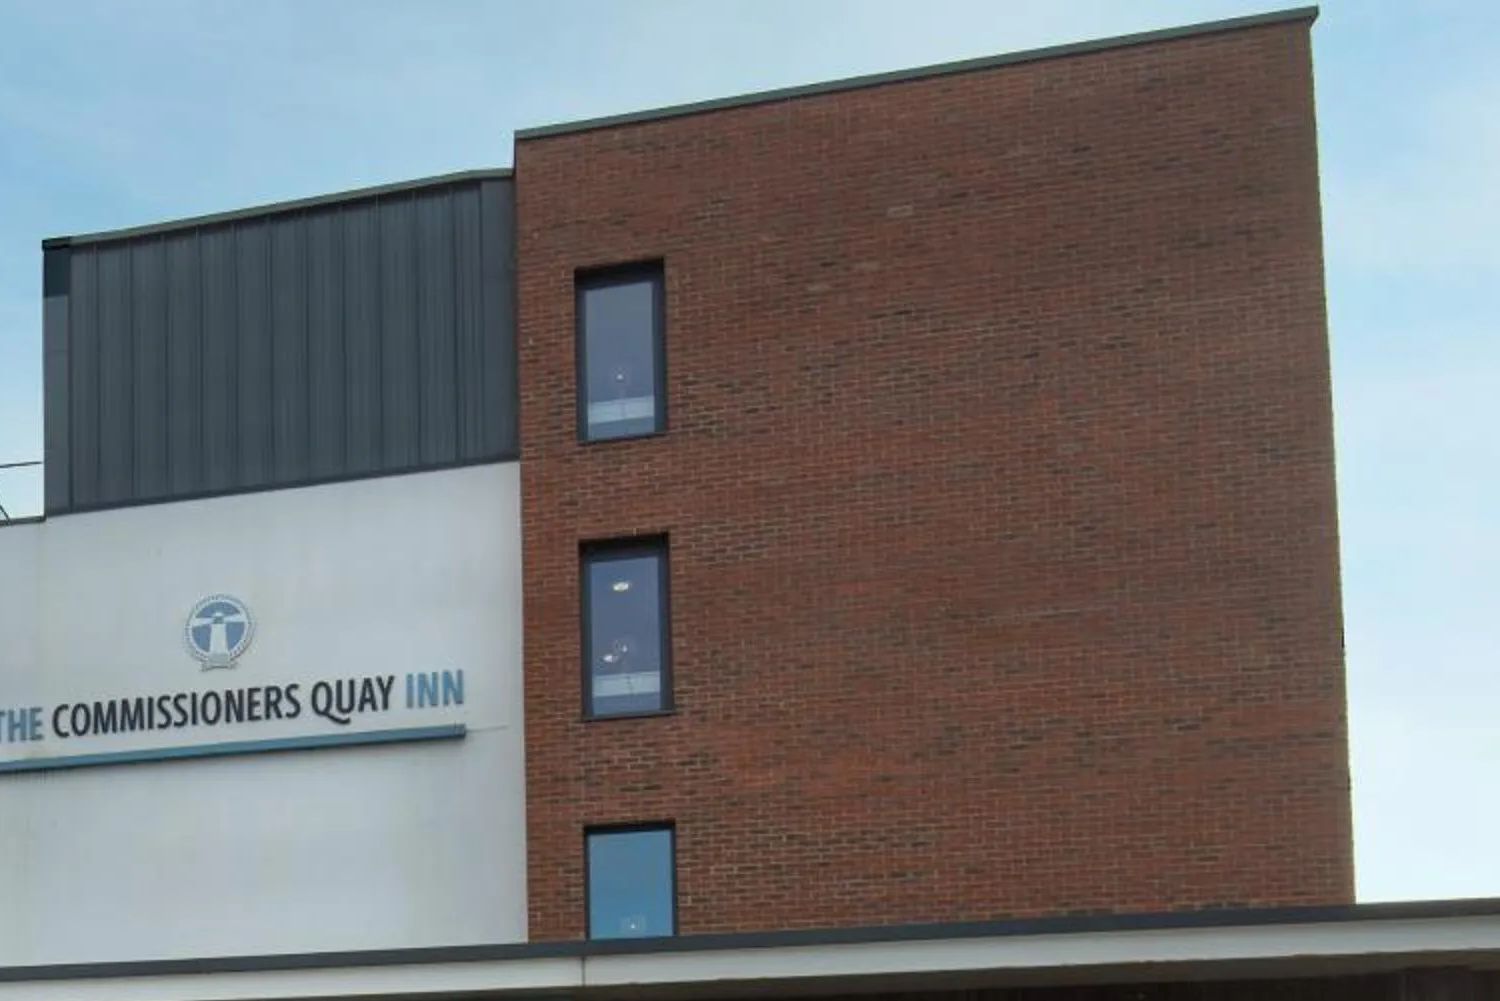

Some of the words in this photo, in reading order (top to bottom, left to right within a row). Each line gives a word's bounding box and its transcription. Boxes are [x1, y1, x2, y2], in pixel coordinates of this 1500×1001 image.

[52, 684, 302, 739] COMMISSIONERS
[310, 675, 395, 726] QUAY
[405, 669, 465, 709] INN
